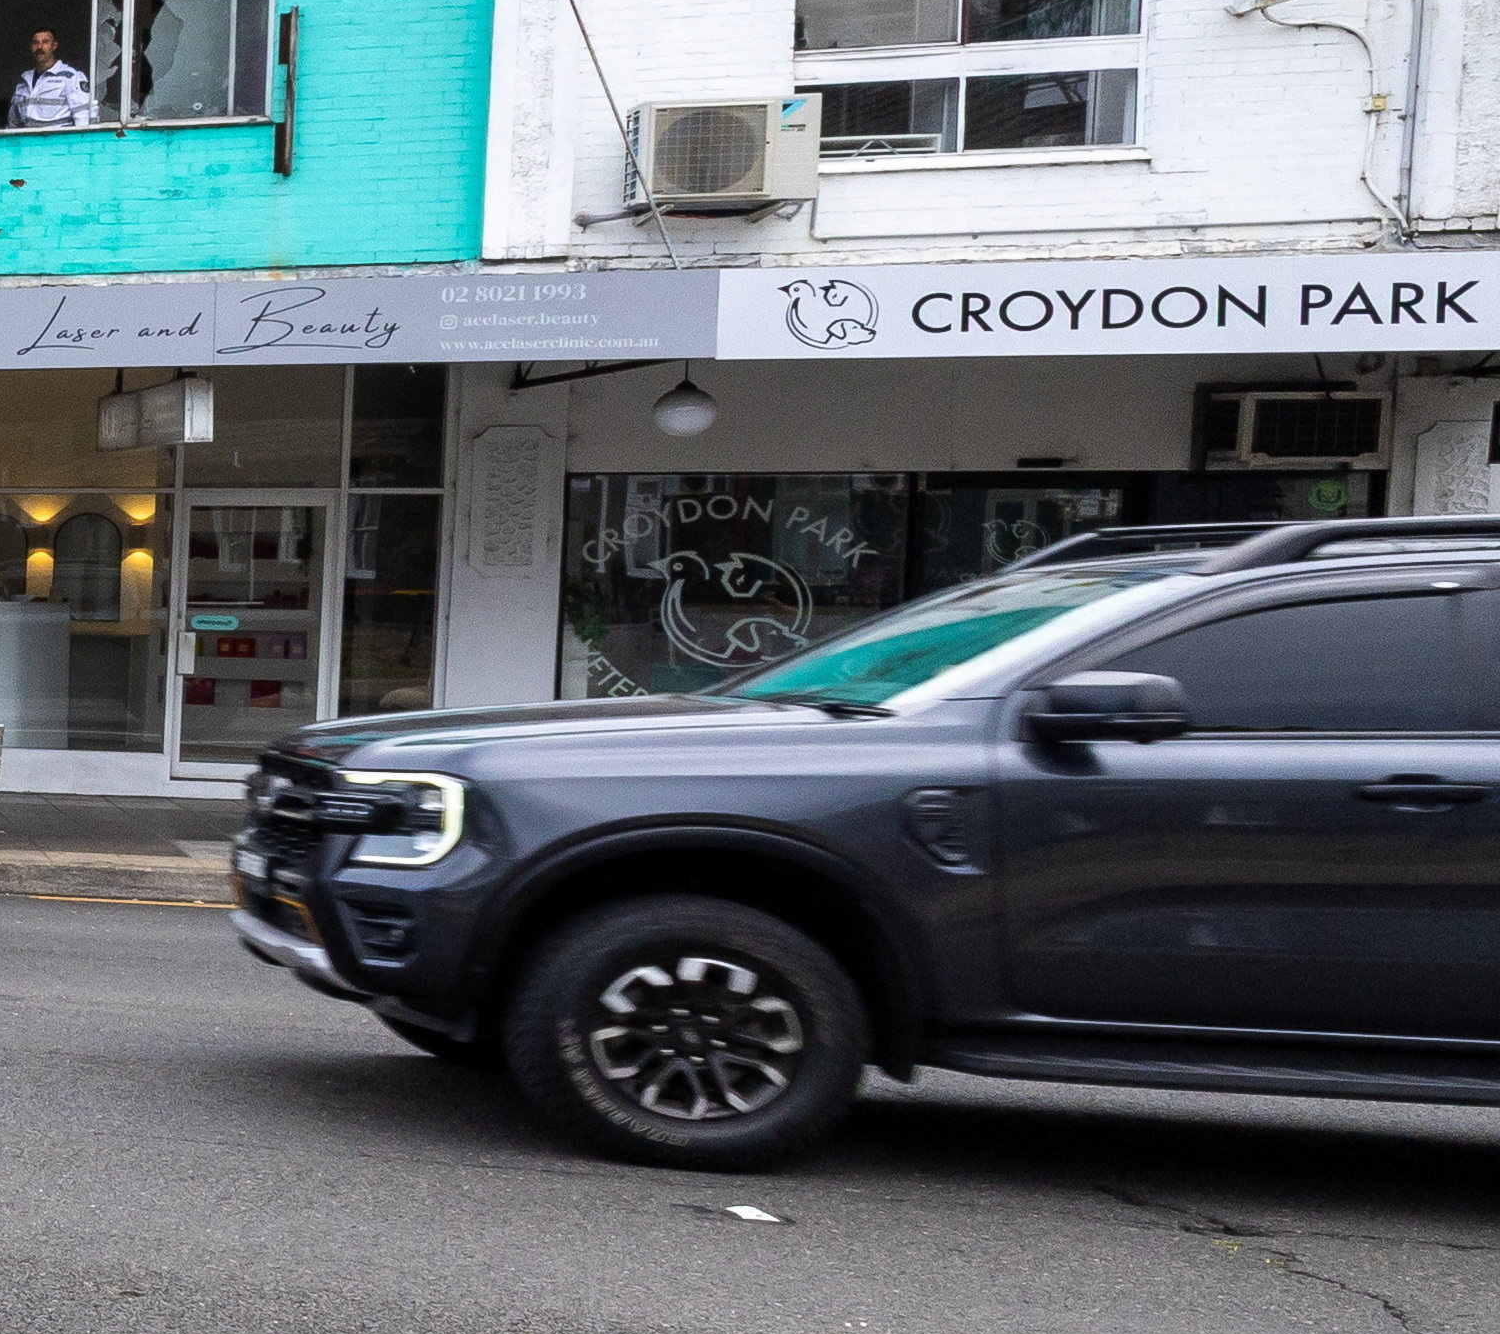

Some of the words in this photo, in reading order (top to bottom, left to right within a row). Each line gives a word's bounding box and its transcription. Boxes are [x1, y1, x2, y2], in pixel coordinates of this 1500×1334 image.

[16, 295, 120, 356] Laser
[138, 312, 202, 338] and
[216, 286, 402, 356] Beauty
[441, 286, 469, 304] 02
[474, 284, 526, 303] 8021
[534, 283, 587, 302] 1993
[911, 285, 1268, 334] CROYDON
[1299, 280, 1481, 326] PARK
[582, 495, 774, 566] CROYDON
[785, 506, 884, 569] PARK
